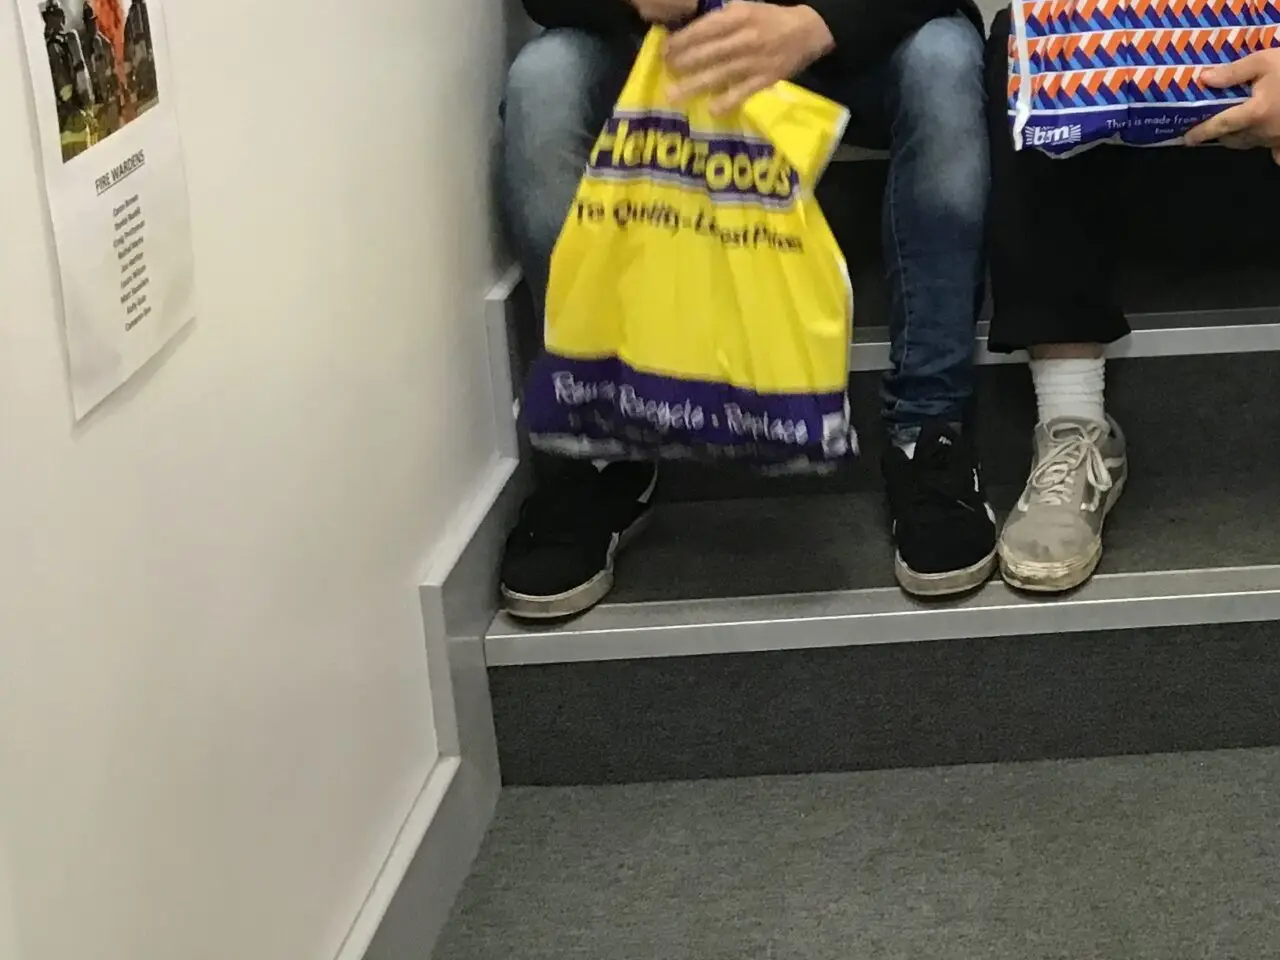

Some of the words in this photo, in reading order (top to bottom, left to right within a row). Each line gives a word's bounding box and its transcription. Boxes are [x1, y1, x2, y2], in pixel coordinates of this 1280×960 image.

[1144, 114, 1171, 125] made
[1173, 113, 1198, 125] from
[94, 172, 111, 192] FIRE
[111, 149, 145, 181] WARDENS
